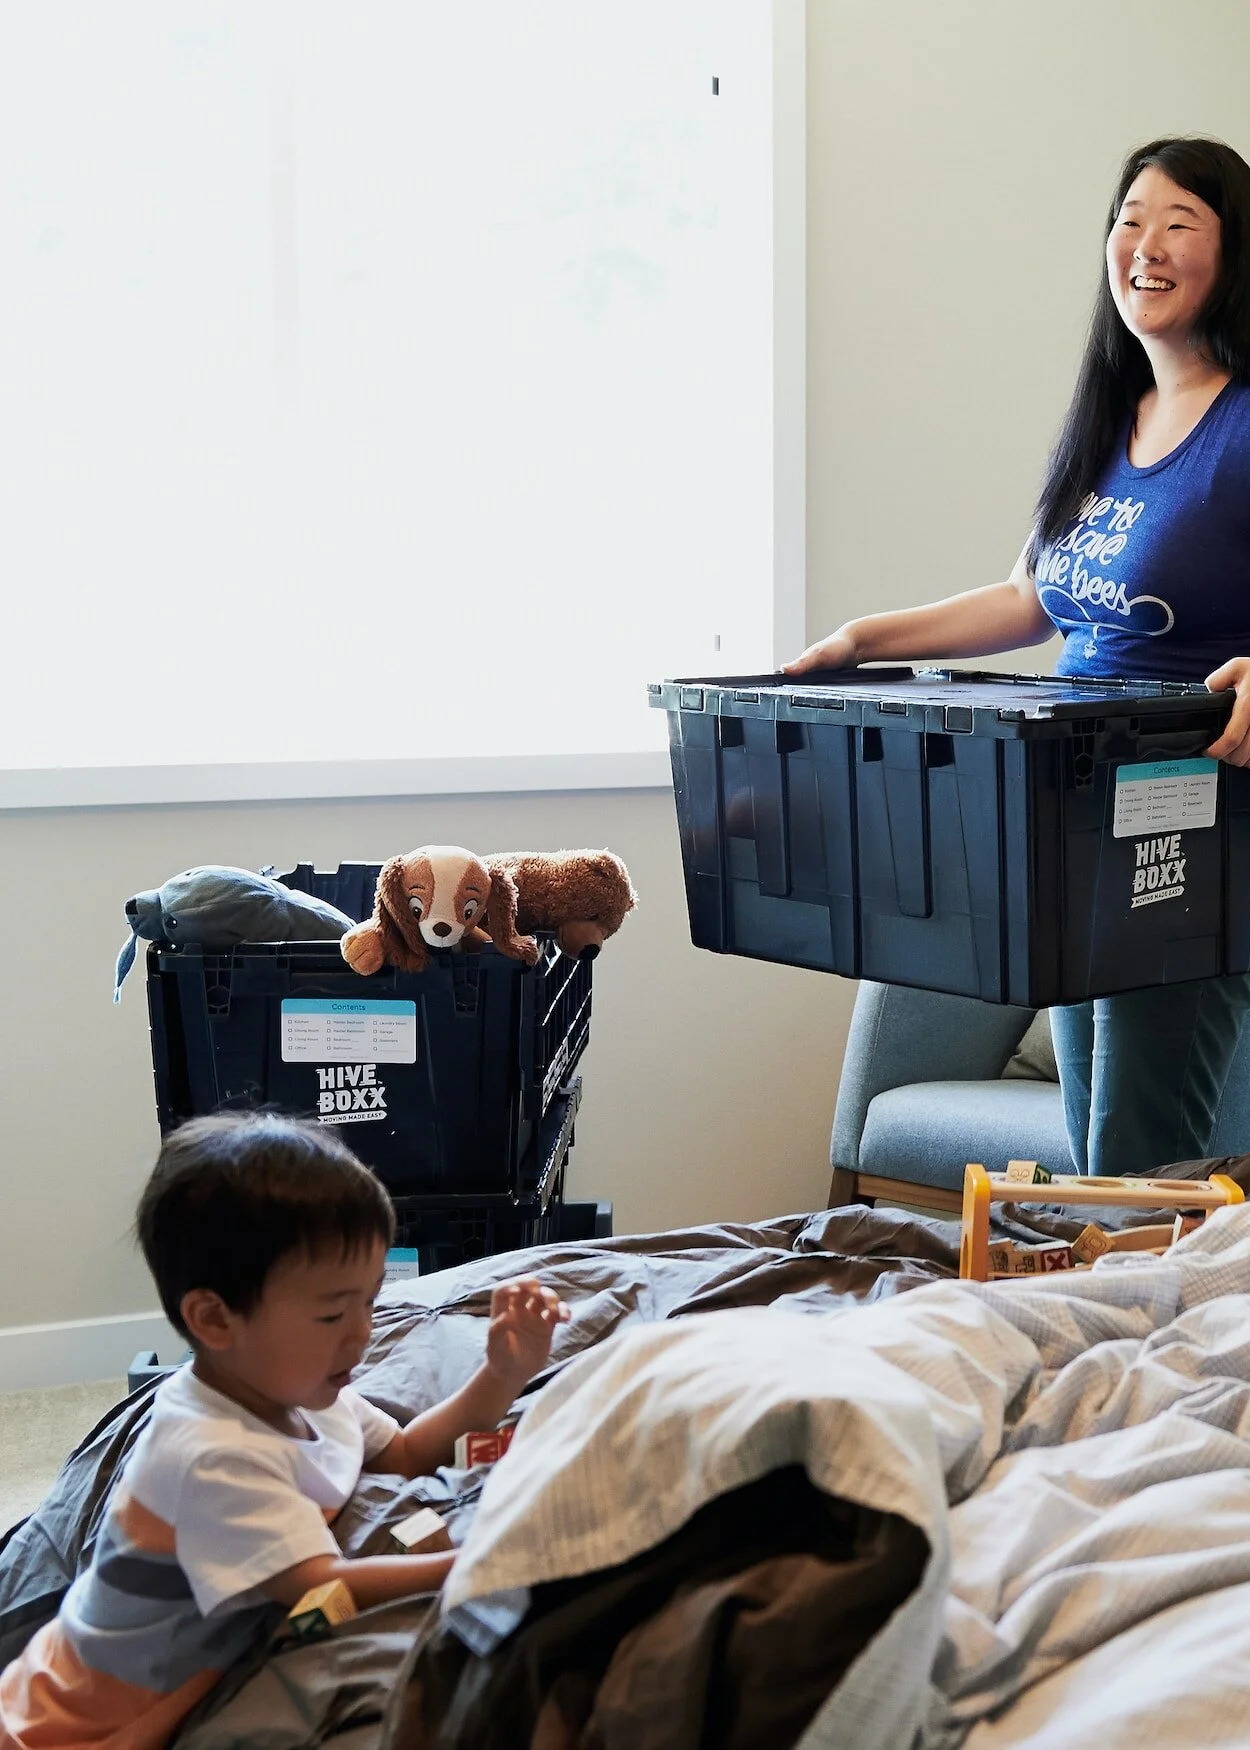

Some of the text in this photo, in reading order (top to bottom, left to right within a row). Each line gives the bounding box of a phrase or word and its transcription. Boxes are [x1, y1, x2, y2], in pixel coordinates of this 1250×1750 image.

[1108, 496, 1145, 532] to
[1056, 524, 1128, 566] save
[1071, 554, 1132, 616] bees
[1153, 765, 1180, 774] Contents
[1135, 834, 1182, 867] HIVE
[1132, 858, 1187, 894] BOXX
[331, 1003, 366, 1011] Contents
[315, 1064, 377, 1090] HIVE
[316, 1087, 388, 1114] BOXX
[323, 1115, 347, 1123] MOVING
